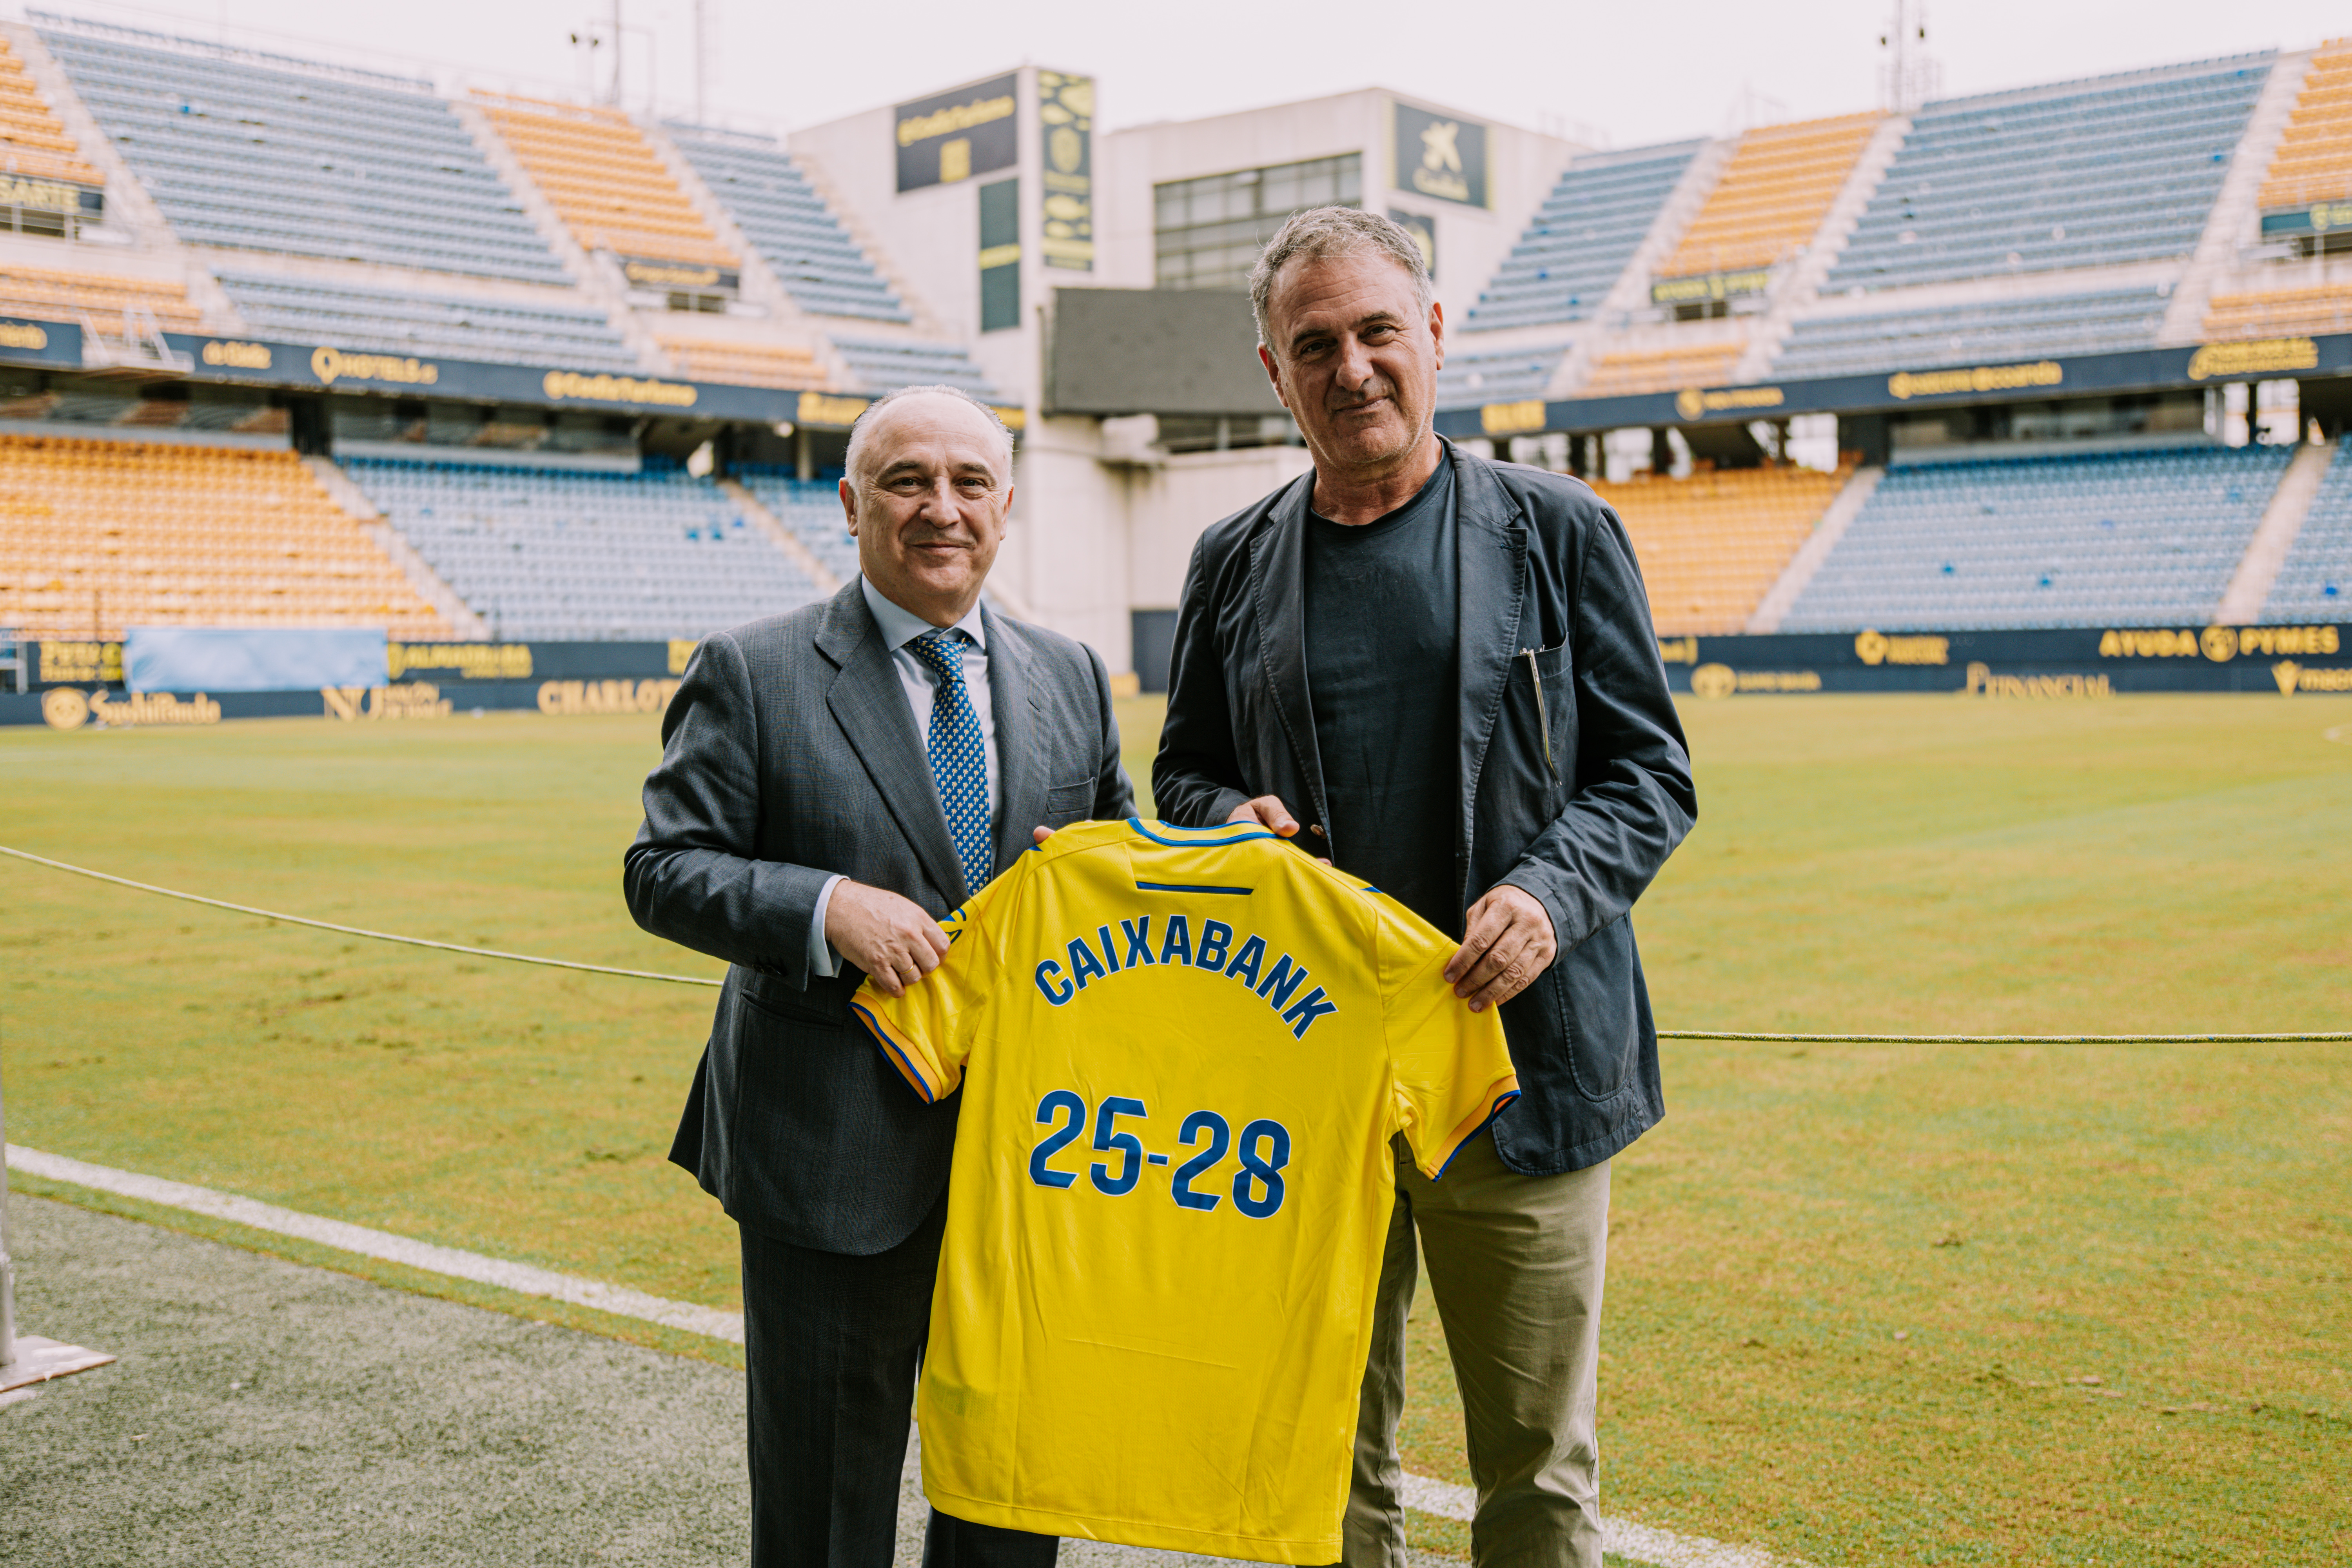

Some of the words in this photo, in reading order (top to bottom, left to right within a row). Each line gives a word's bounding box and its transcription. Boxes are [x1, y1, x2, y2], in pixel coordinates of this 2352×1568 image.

[2099, 630, 2198, 657] AYUDA
[2239, 626, 2340, 655] PYMES
[1035, 915, 1338, 1041] CAIXABANK
[1029, 1089, 1291, 1219] 25-28
